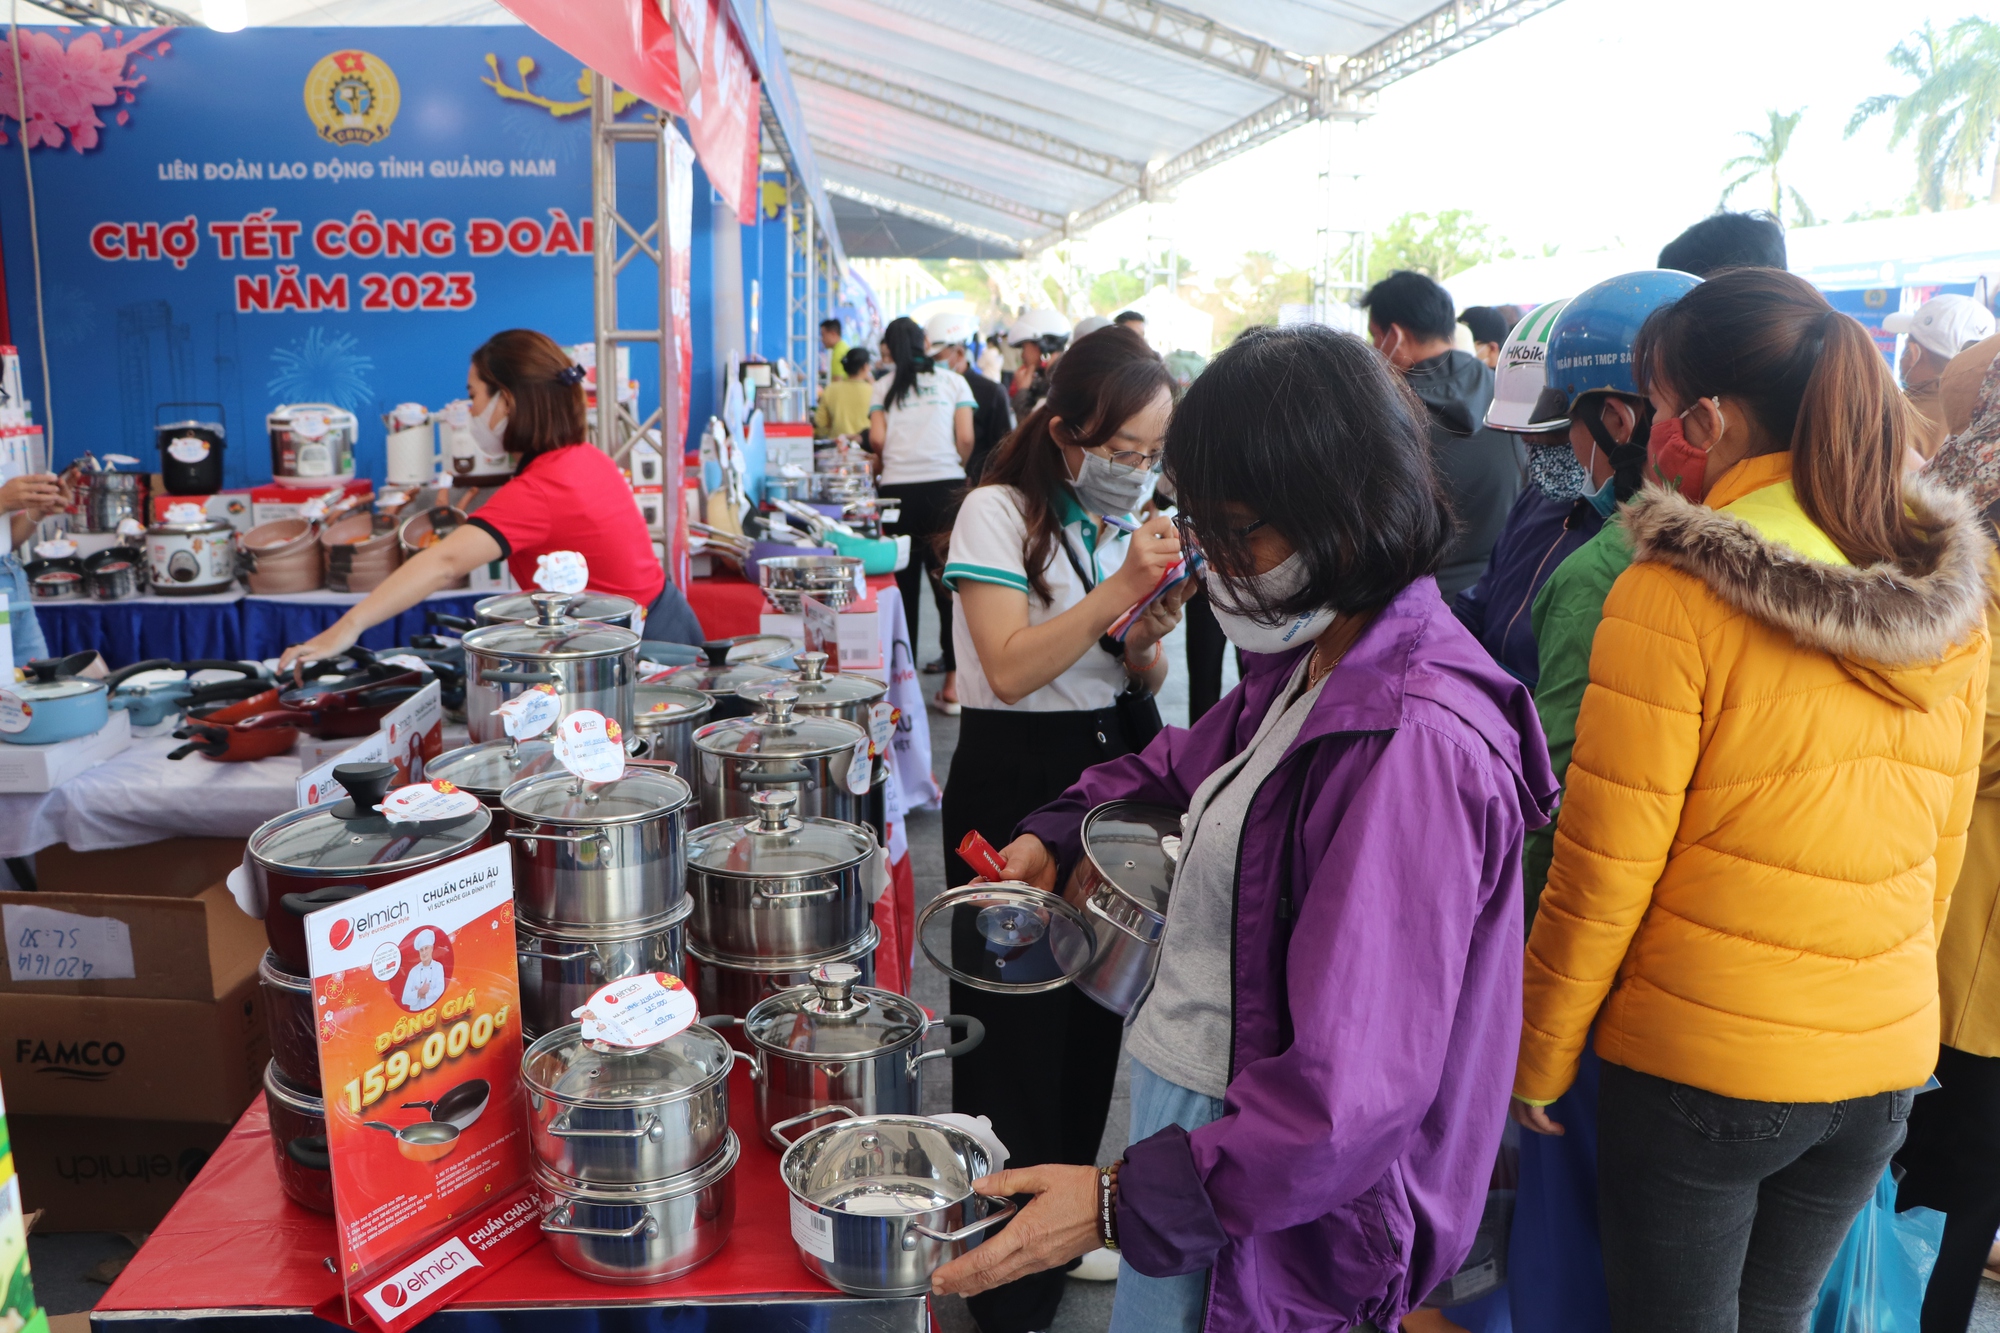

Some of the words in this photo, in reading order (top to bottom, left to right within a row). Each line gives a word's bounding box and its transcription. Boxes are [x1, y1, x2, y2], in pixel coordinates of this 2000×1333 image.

[158, 158, 198, 180] LIÊN
[204, 158, 263, 180] ĐOÀN
[269, 162, 307, 180] LAO
[313, 157, 374, 183] ĐỘNG
[379, 155, 424, 177] TỈNH
[429, 154, 504, 177] QUẢNG
[510, 159, 556, 176] NAM
[90, 214, 199, 270] CHỢ
[209, 208, 302, 260] TẾT
[313, 210, 456, 259] CÔNG
[235, 264, 349, 312] NĂM
[360, 272, 477, 311] 2023
[1595, 353, 1618, 365] TMCP
[422, 881, 457, 904] CHUẨN
[459, 871, 485, 889] CHÂU
[486, 866, 500, 880] ÂU
[462, 889, 472, 900] GIA
[356, 901, 410, 932] elmich
[375, 1008, 438, 1054] ĐỒNG
[441, 988, 477, 1021] GIÁ
[16, 1039, 126, 1066] FAMCO
[55, 1153, 172, 1185] elmich
[468, 1217, 507, 1246] CHUẨN
[503, 1197, 533, 1223] CHÂU
[406, 1250, 465, 1292] elmich
